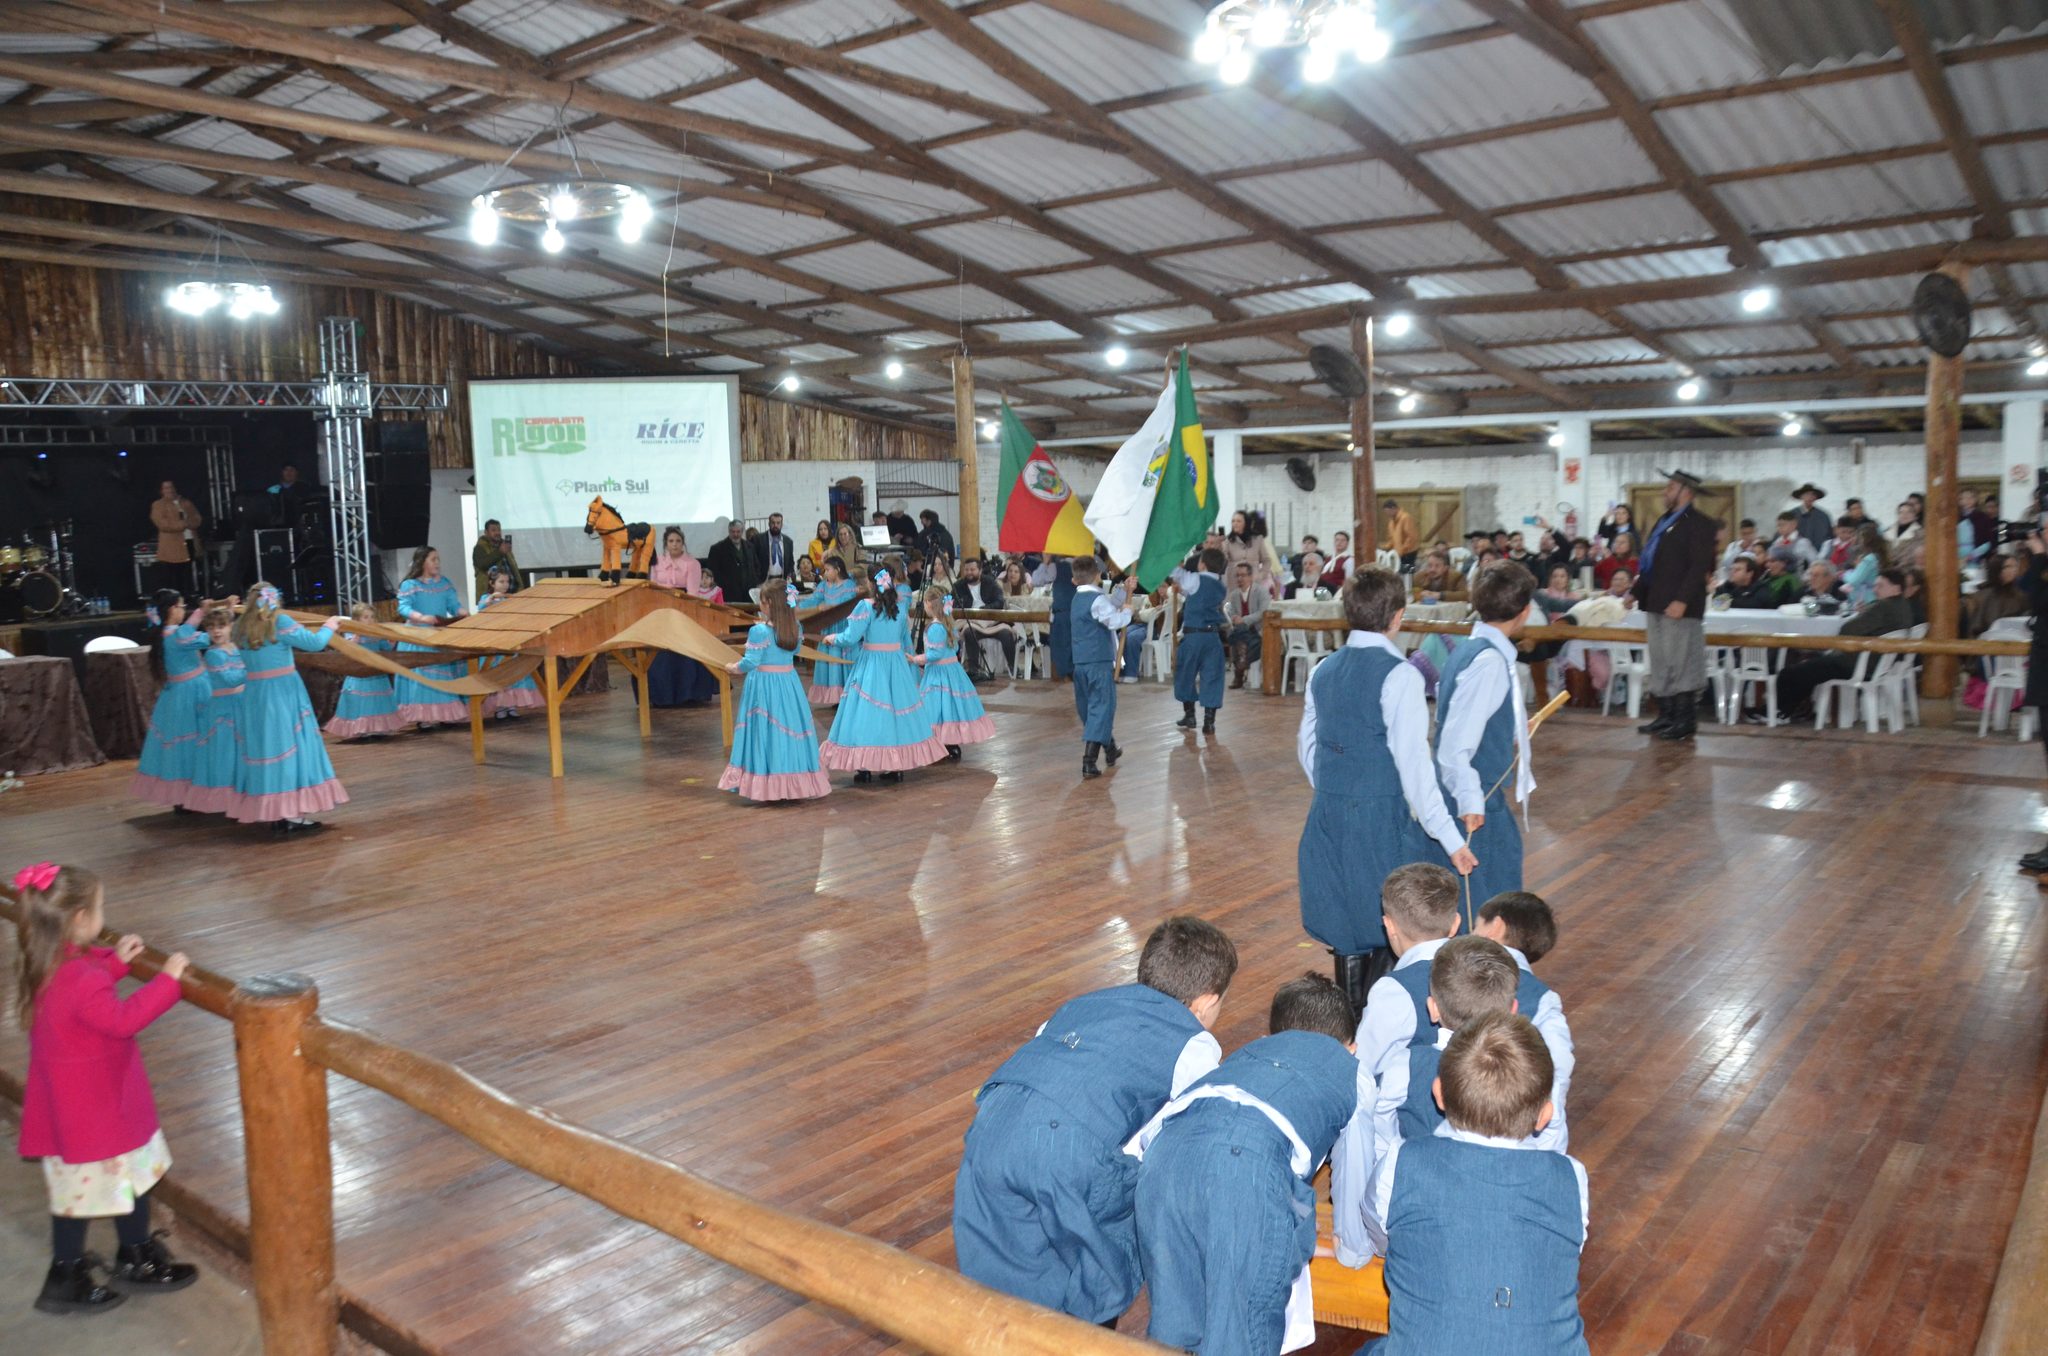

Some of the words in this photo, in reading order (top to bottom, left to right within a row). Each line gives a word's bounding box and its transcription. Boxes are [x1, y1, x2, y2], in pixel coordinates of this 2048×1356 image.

[491, 417, 586, 457] Rigon
[574, 476, 622, 493] Planta
[625, 479, 650, 491] Sul
